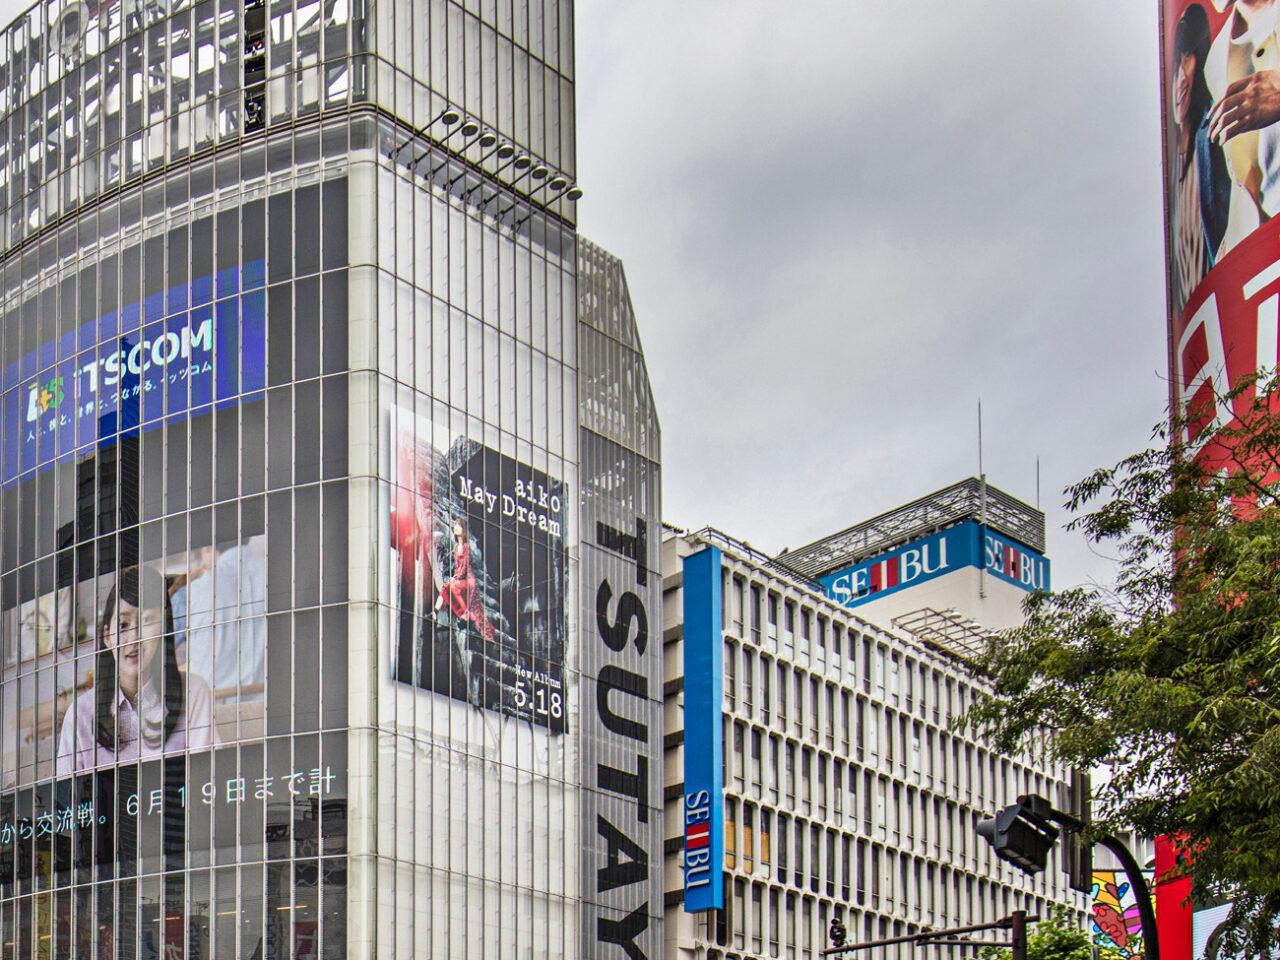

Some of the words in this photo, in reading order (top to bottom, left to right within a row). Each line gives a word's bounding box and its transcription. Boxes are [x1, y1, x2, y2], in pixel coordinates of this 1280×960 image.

[458, 475, 498, 513] May
[501, 494, 561, 538] Dream
[514, 477, 561, 512] aiko
[831, 536, 949, 606] SEIBU
[984, 535, 1044, 590] SEIBU
[514, 663, 533, 680] New
[533, 670, 561, 688] Album
[514, 681, 562, 719] 5.18
[686, 788, 711, 890] SEIBU
